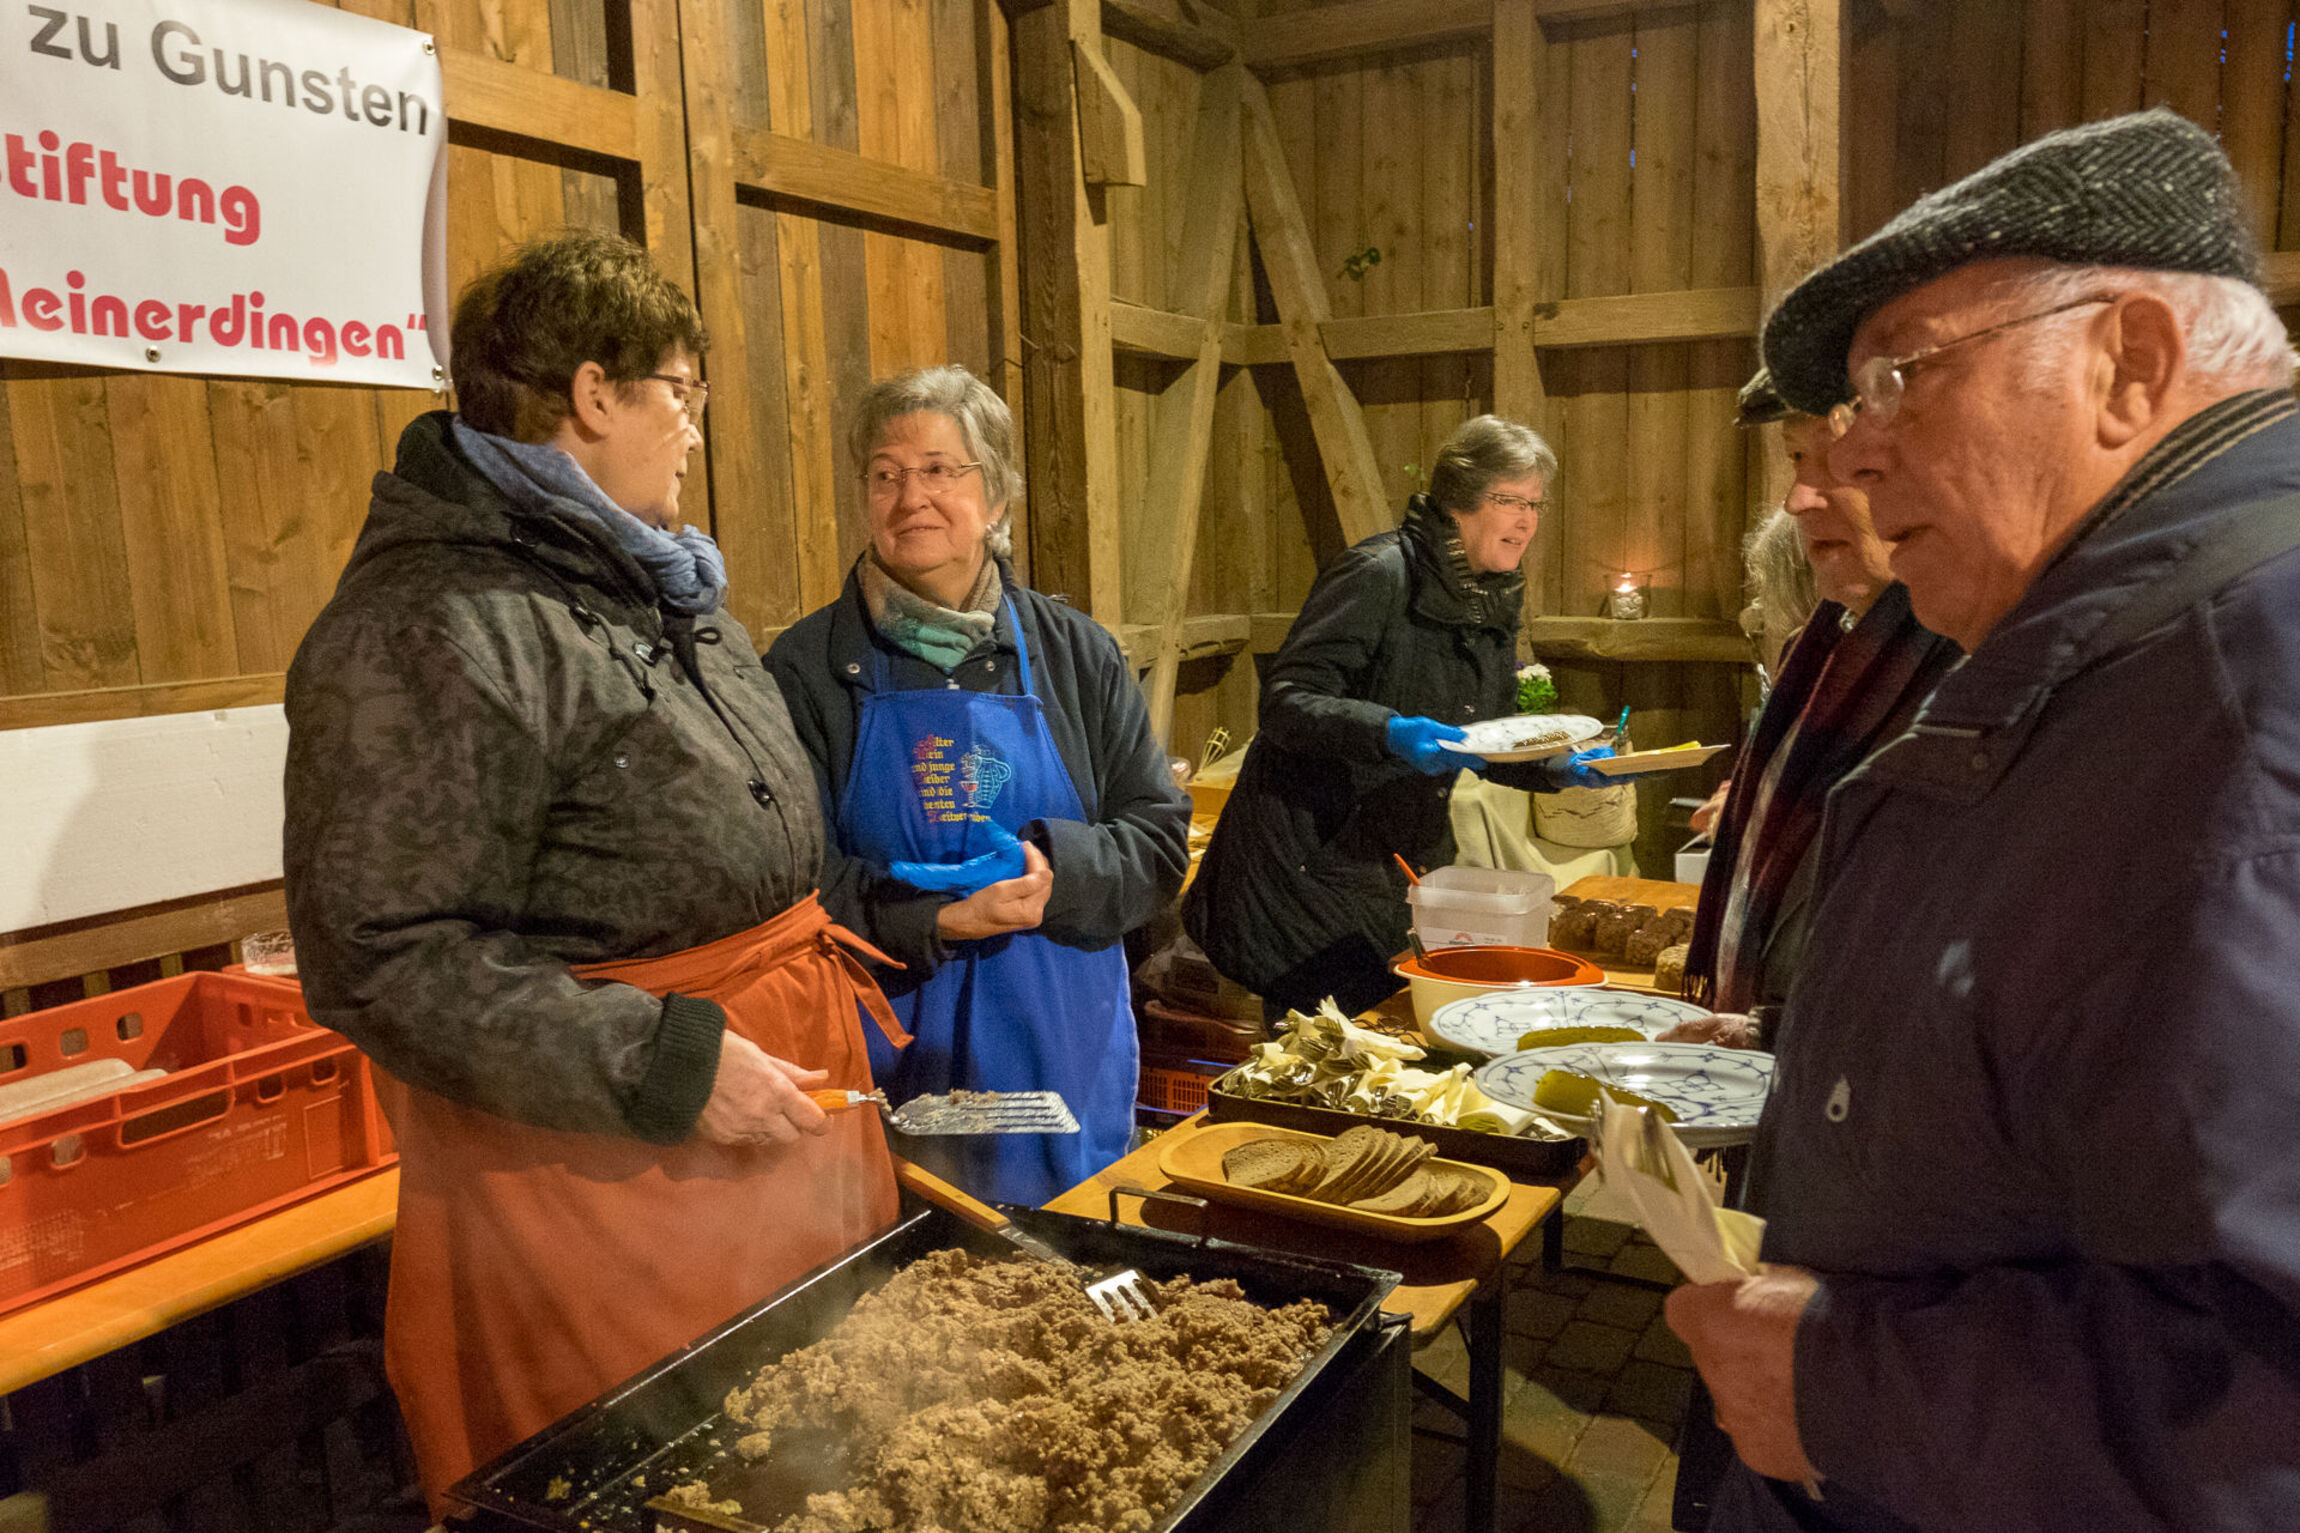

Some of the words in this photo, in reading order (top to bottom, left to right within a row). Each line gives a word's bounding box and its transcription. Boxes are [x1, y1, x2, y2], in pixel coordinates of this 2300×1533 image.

[28, 4, 122, 71] zu
[150, 19, 429, 136] Gunsten
[0, 129, 261, 247] tiftung
